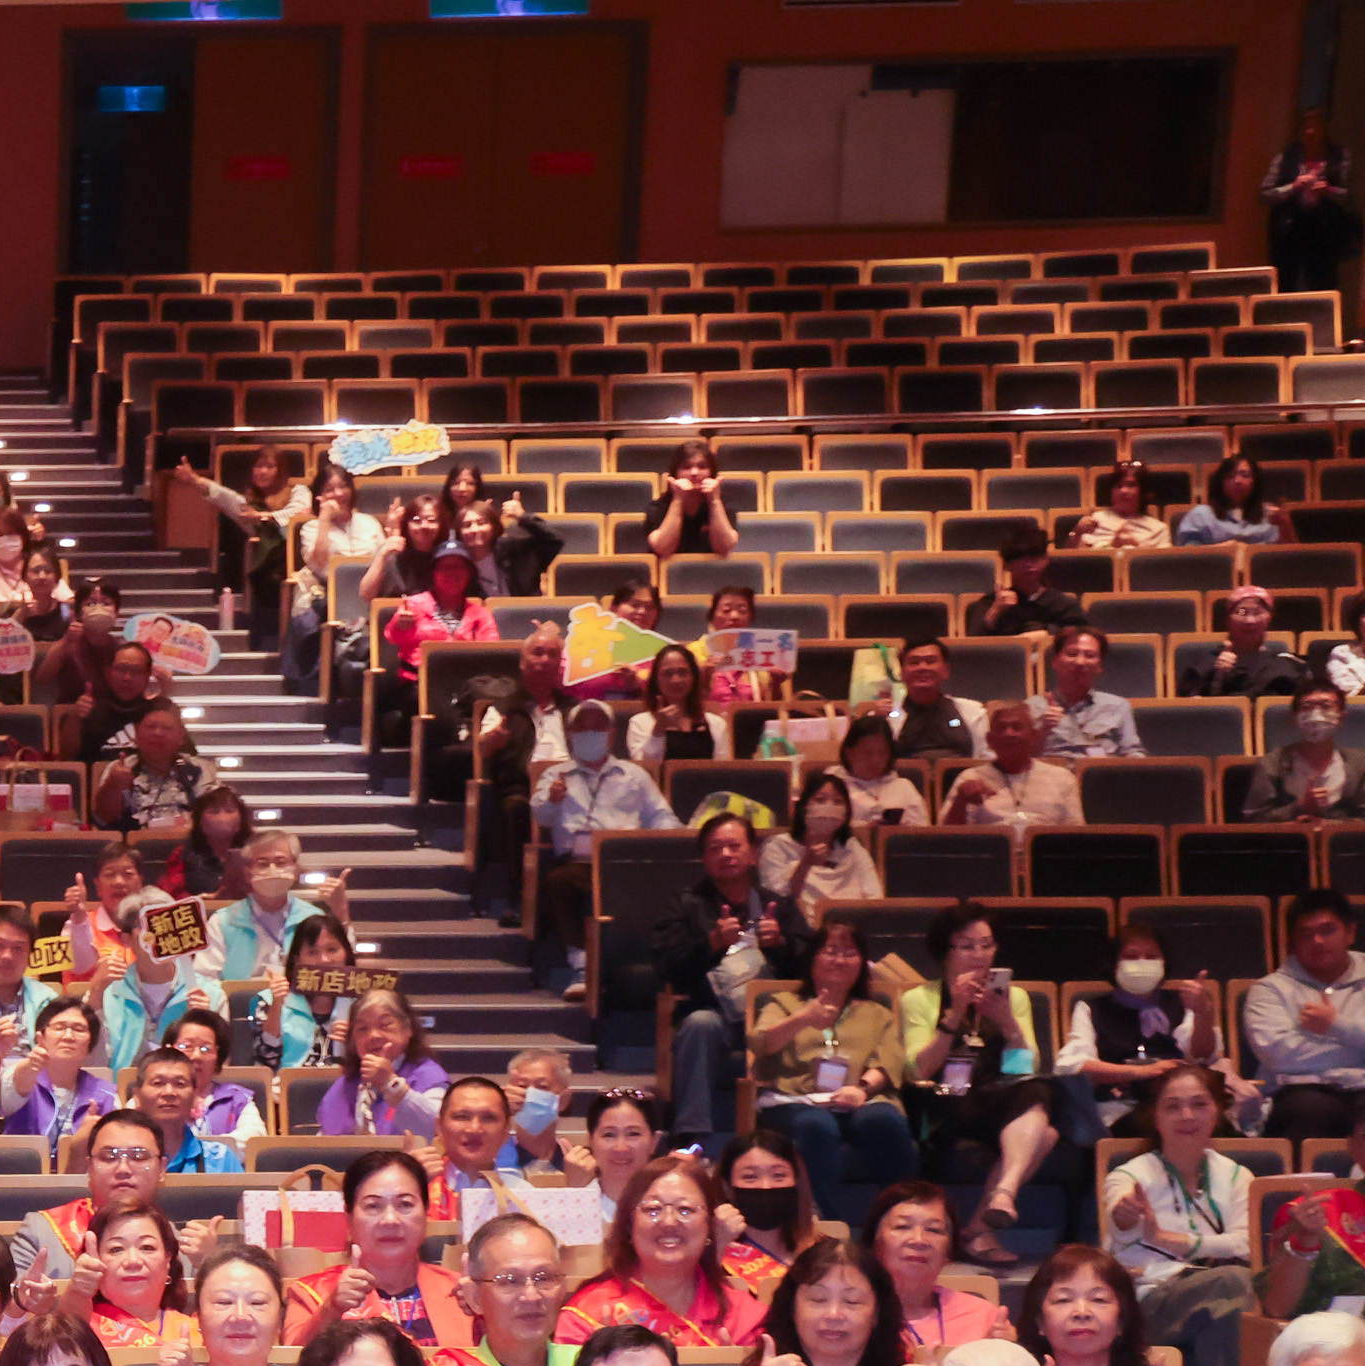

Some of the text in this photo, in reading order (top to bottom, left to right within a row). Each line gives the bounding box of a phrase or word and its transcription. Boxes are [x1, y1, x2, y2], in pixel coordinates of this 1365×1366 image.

[150, 906, 195, 932] 新店
[160, 926, 205, 954] 地政
[296, 968, 397, 995] 新店地政
